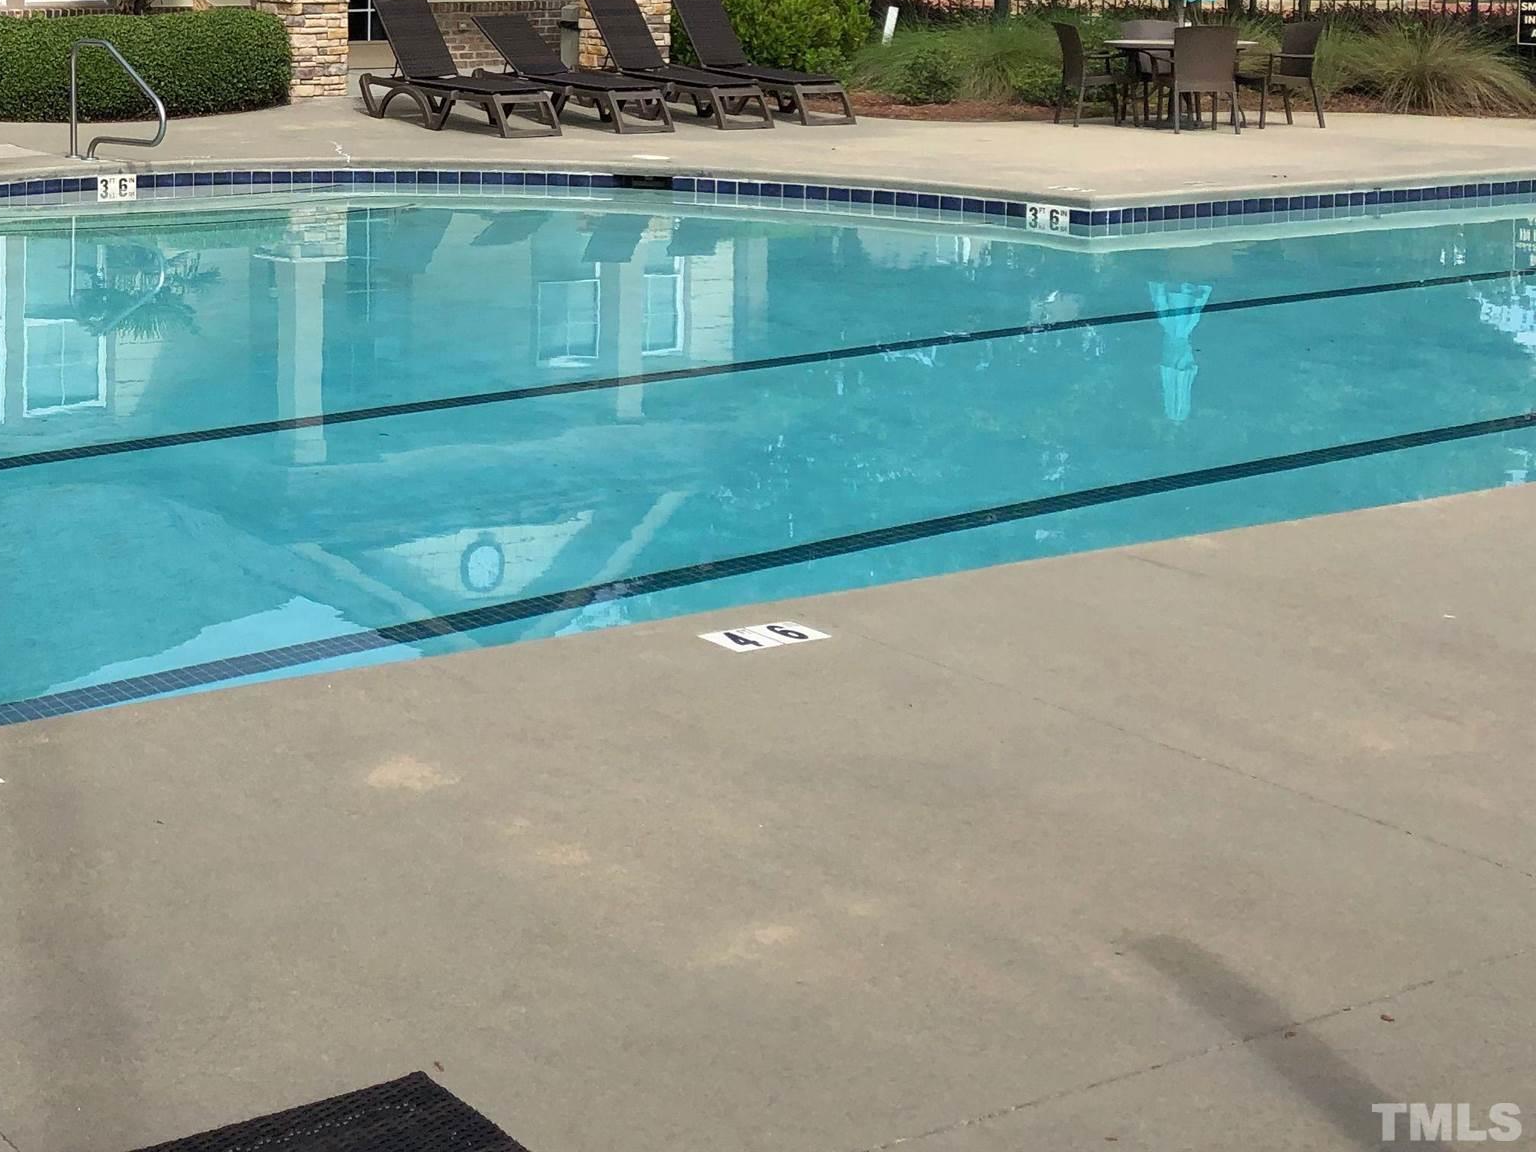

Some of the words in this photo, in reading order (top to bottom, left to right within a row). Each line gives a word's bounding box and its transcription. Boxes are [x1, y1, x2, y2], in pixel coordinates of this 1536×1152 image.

[119, 178, 128, 192] 6
[1029, 207, 1038, 221] 3
[1050, 209, 1060, 224] 6
[723, 631, 764, 647] 4
[766, 625, 809, 640] 6
